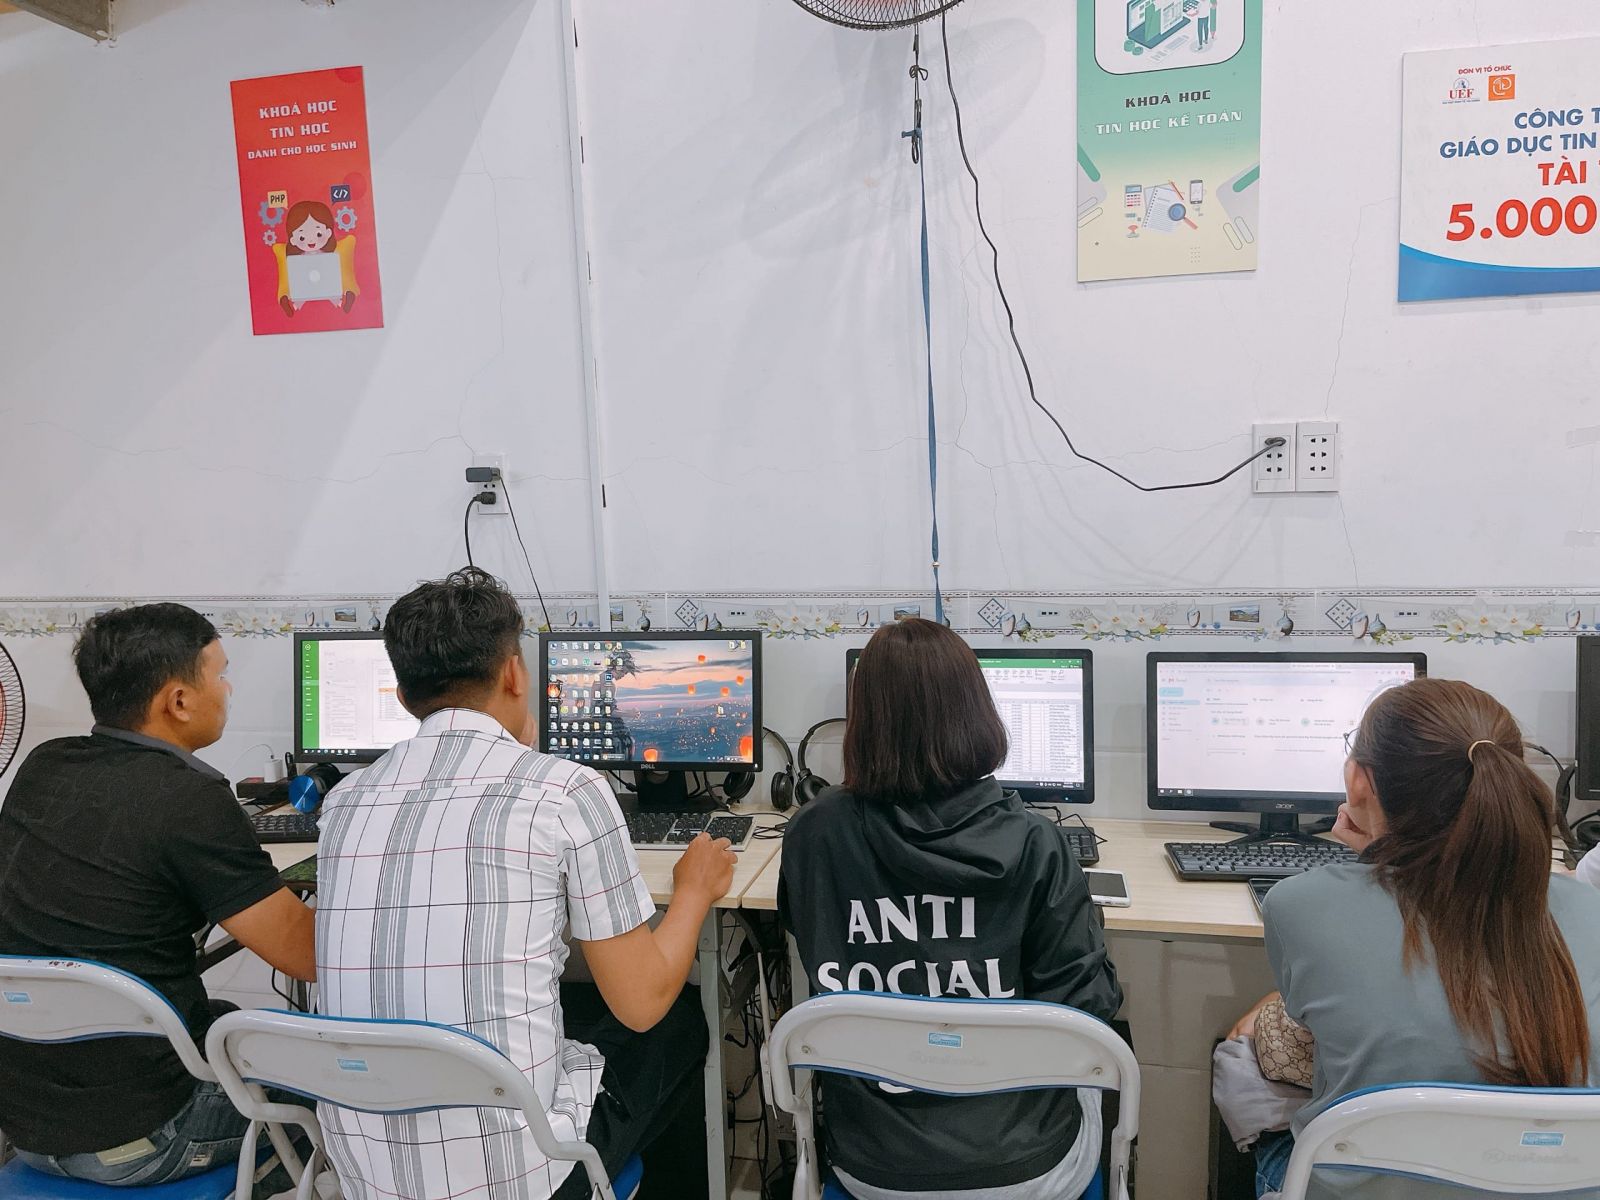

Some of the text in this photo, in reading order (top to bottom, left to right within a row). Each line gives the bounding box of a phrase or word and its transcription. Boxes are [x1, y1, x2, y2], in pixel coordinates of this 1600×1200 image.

[1178, 90, 1211, 104] HỌC
[1449, 88, 1474, 99] UEF
[307, 100, 337, 114] HỌC
[1514, 107, 1584, 129] CÔNG
[270, 122, 330, 139] TIN HỌC
[1095, 123, 1122, 135] TIN
[1129, 119, 1161, 132] HỌC
[281, 146, 302, 156] CHO
[306, 143, 327, 153] HỌC
[330, 141, 357, 151] SINH
[1440, 132, 1597, 158] GIÁO DỤC TIN
[1538, 155, 1587, 186] TÀI
[270, 194, 286, 204] PHP
[1446, 195, 1598, 241] 5.000
[847, 894, 977, 945] ANTI
[817, 958, 1016, 999] SOCIAL
